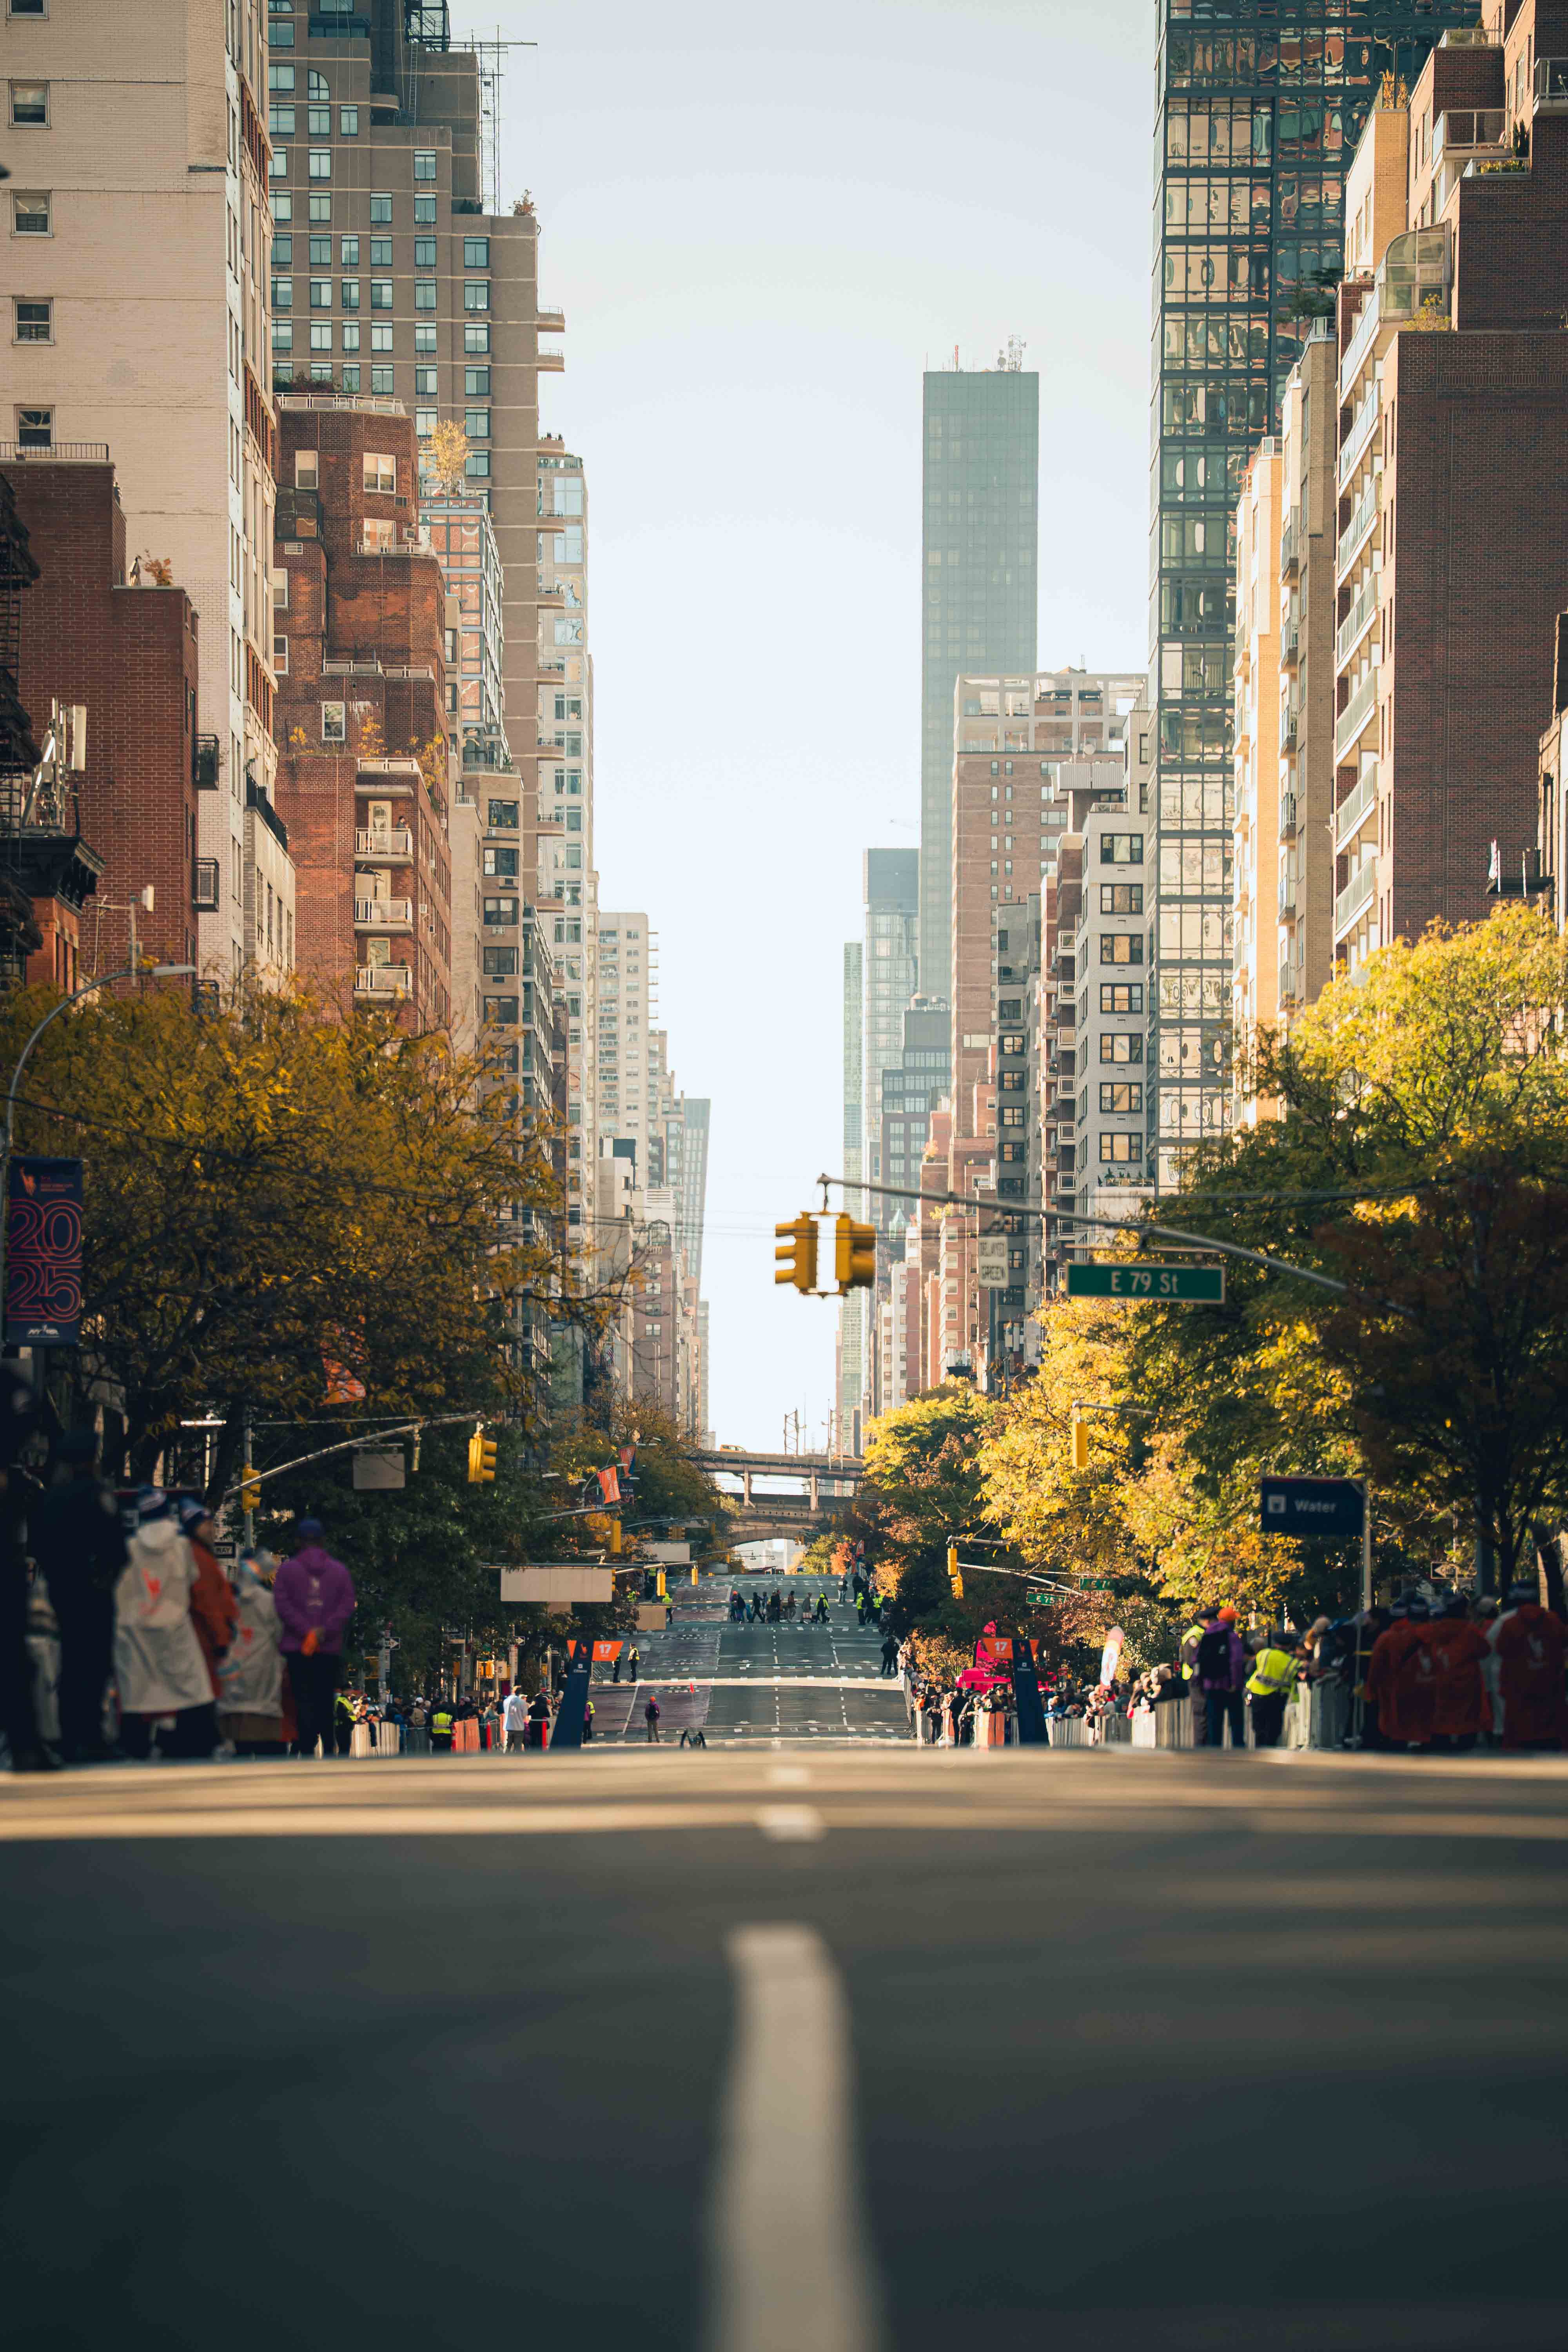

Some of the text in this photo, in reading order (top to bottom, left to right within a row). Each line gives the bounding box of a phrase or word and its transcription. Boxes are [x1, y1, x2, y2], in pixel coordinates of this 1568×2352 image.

[8, 1199, 83, 1264] 20
[981, 1265, 1005, 1281] GREEN
[1111, 1271, 1179, 1294] E 79 St
[7, 1259, 82, 1323] 25
[1295, 1499, 1336, 1512] Water
[599, 1644, 612, 1654] 17
[995, 1641, 1007, 1651] 17
